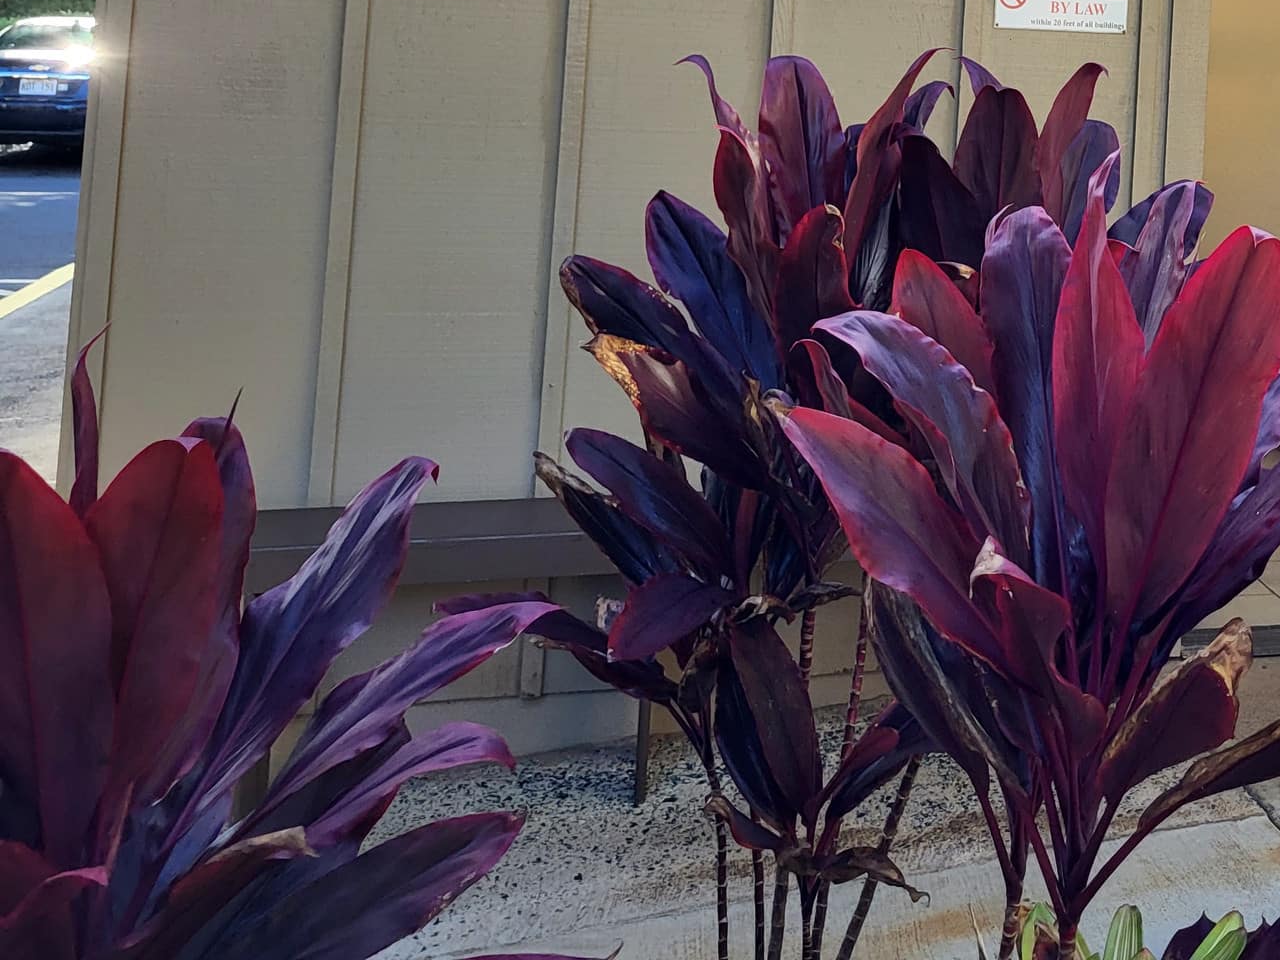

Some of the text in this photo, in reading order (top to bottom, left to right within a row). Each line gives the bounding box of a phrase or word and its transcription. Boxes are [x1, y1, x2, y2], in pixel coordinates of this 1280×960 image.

[1051, 1, 1108, 16] BY LAW
[1094, 21, 1125, 30] buildings
